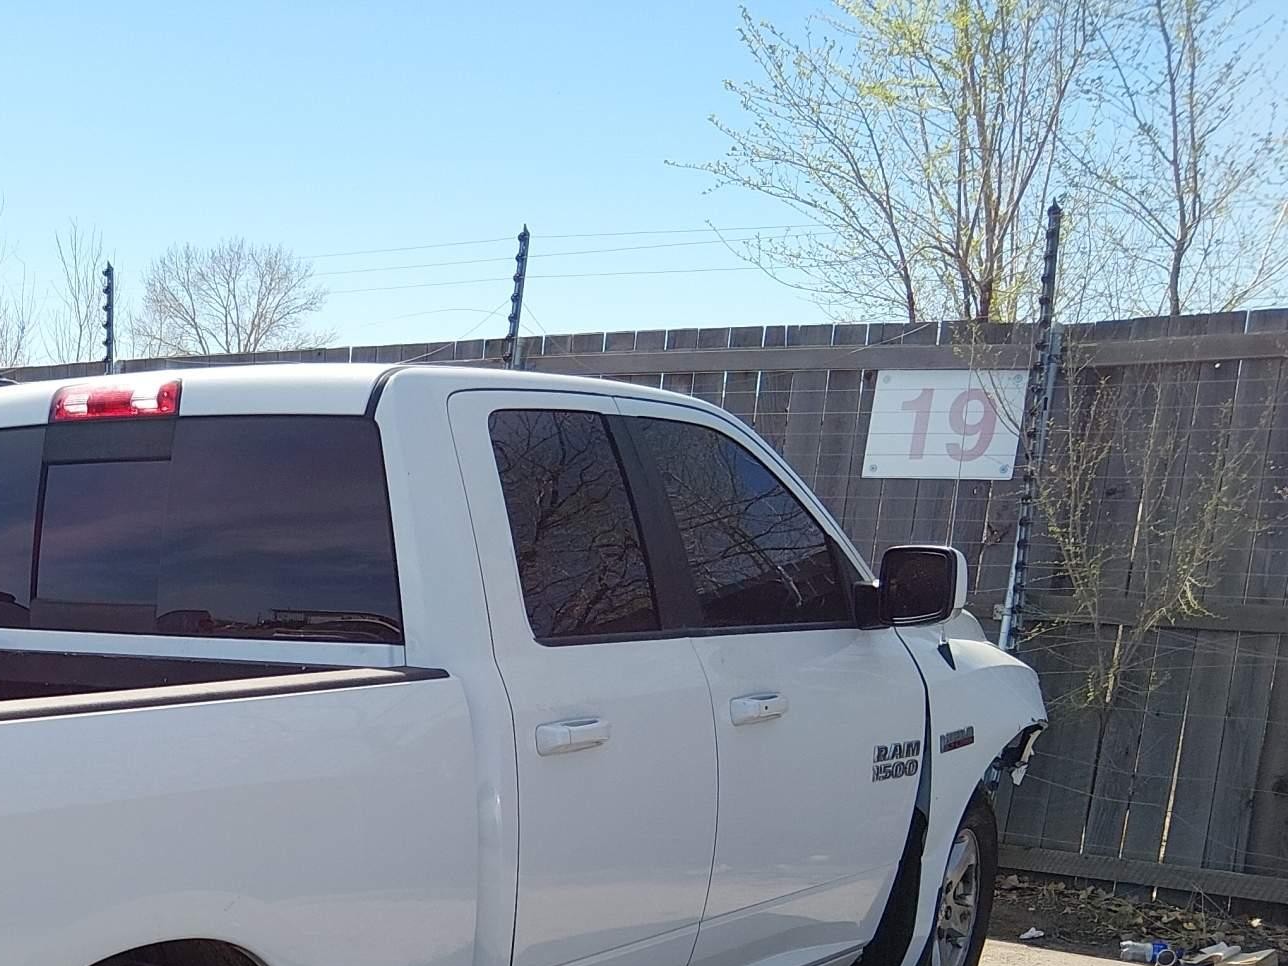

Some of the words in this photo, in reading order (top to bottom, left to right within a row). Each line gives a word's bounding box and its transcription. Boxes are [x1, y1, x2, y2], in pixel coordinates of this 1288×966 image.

[900, 388, 998, 462] 19
[873, 740, 920, 762] RAM
[872, 759, 918, 782] 1500
